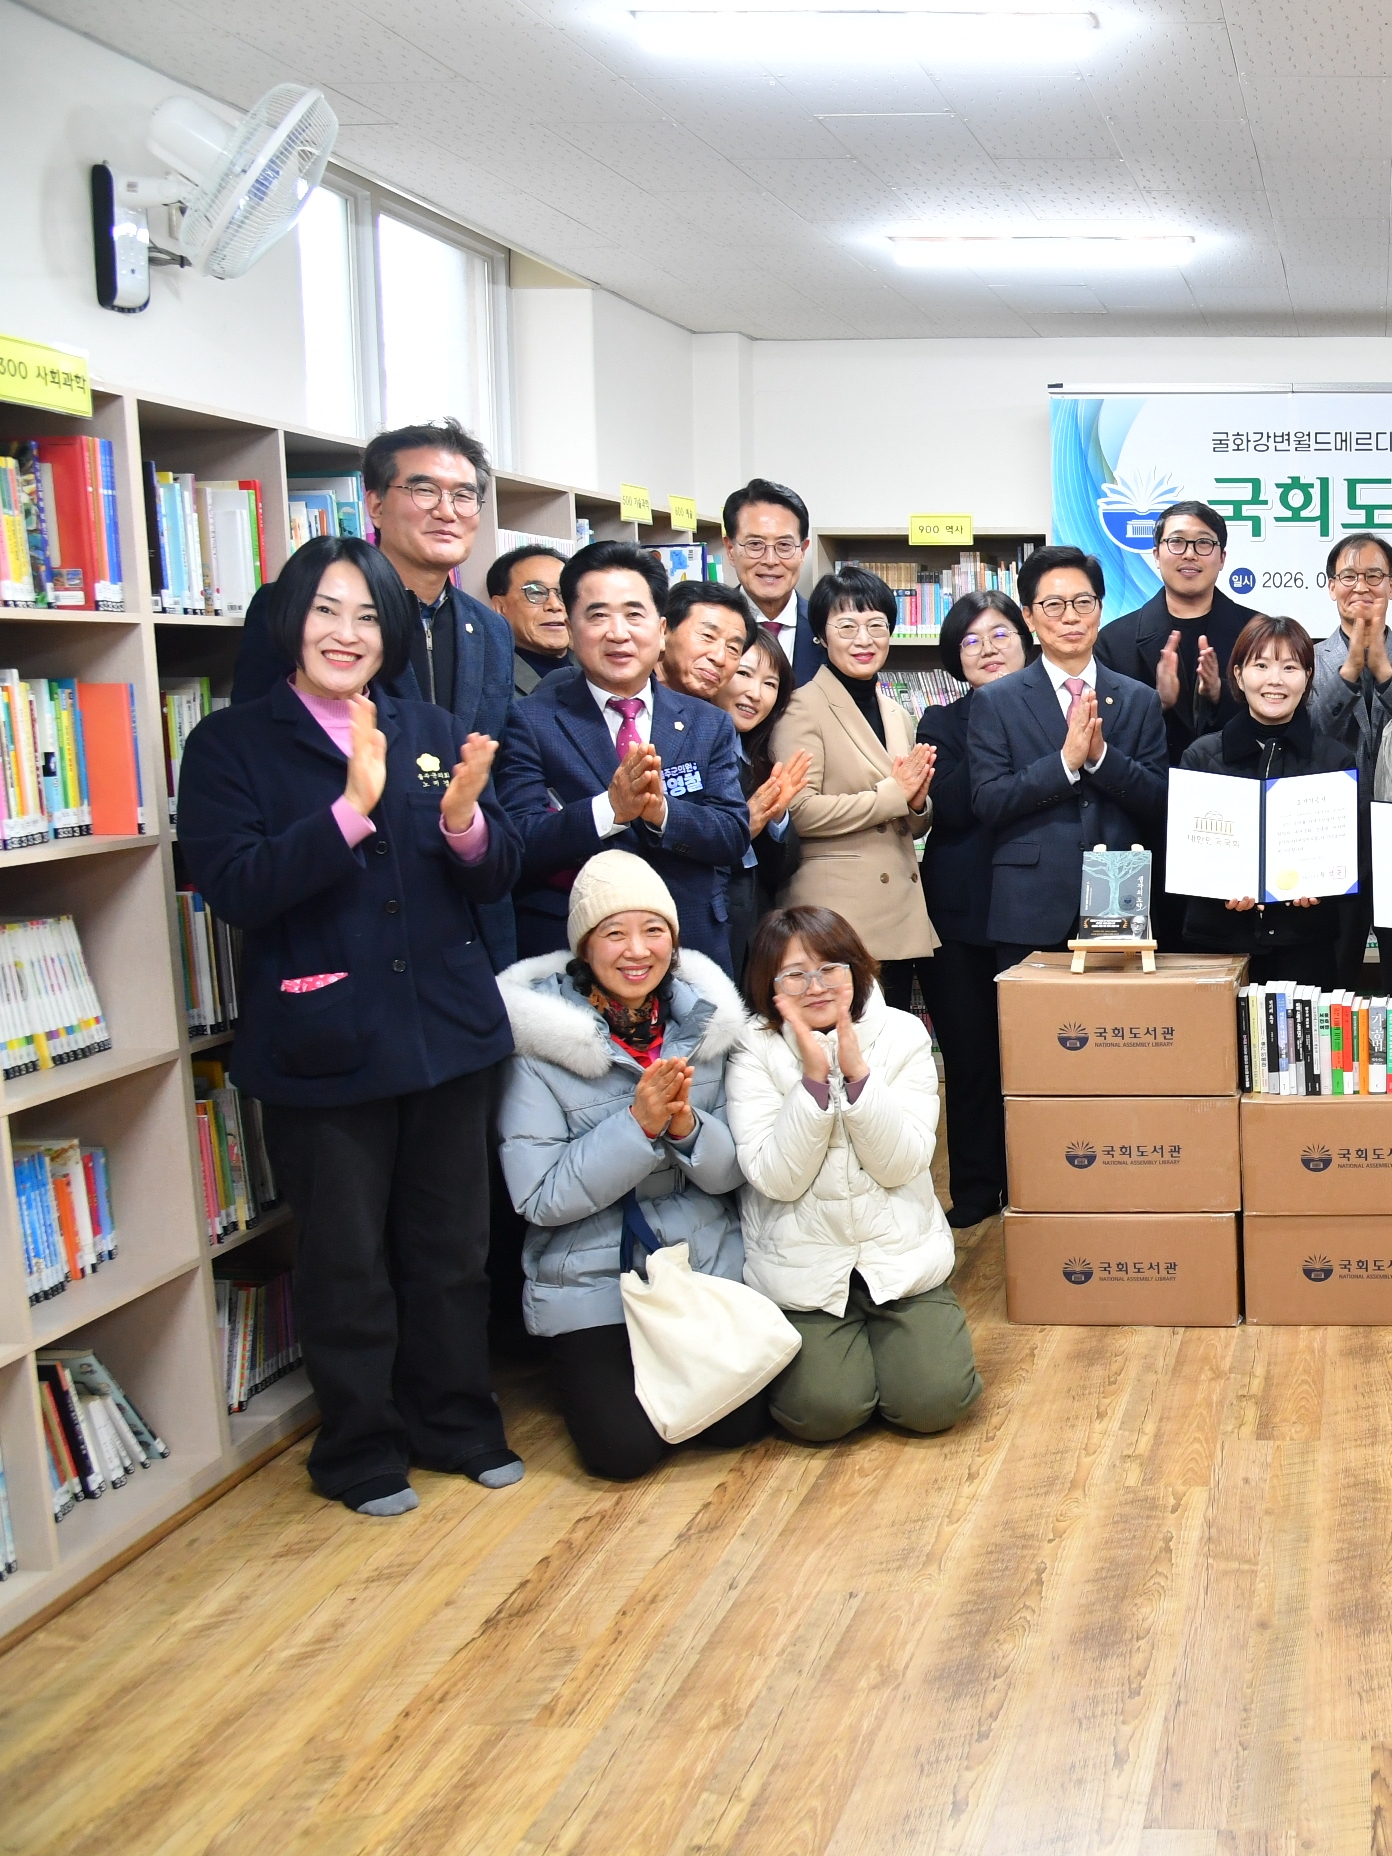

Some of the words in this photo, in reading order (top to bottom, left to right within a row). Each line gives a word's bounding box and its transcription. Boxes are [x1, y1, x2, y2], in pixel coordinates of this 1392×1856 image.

[36, 365, 87, 394] 사회과학
[918, 525, 940, 535] 900
[945, 524, 964, 535] 역사
[1232, 574, 1255, 588] 일시
[1261, 571, 1309, 590] 2026.
[661, 770, 703, 797] 영철
[1094, 1027, 1175, 1040] 국회도서관
[1102, 1145, 1183, 1158] 국회도서관
[1098, 1262, 1178, 1275] 국회도서관
